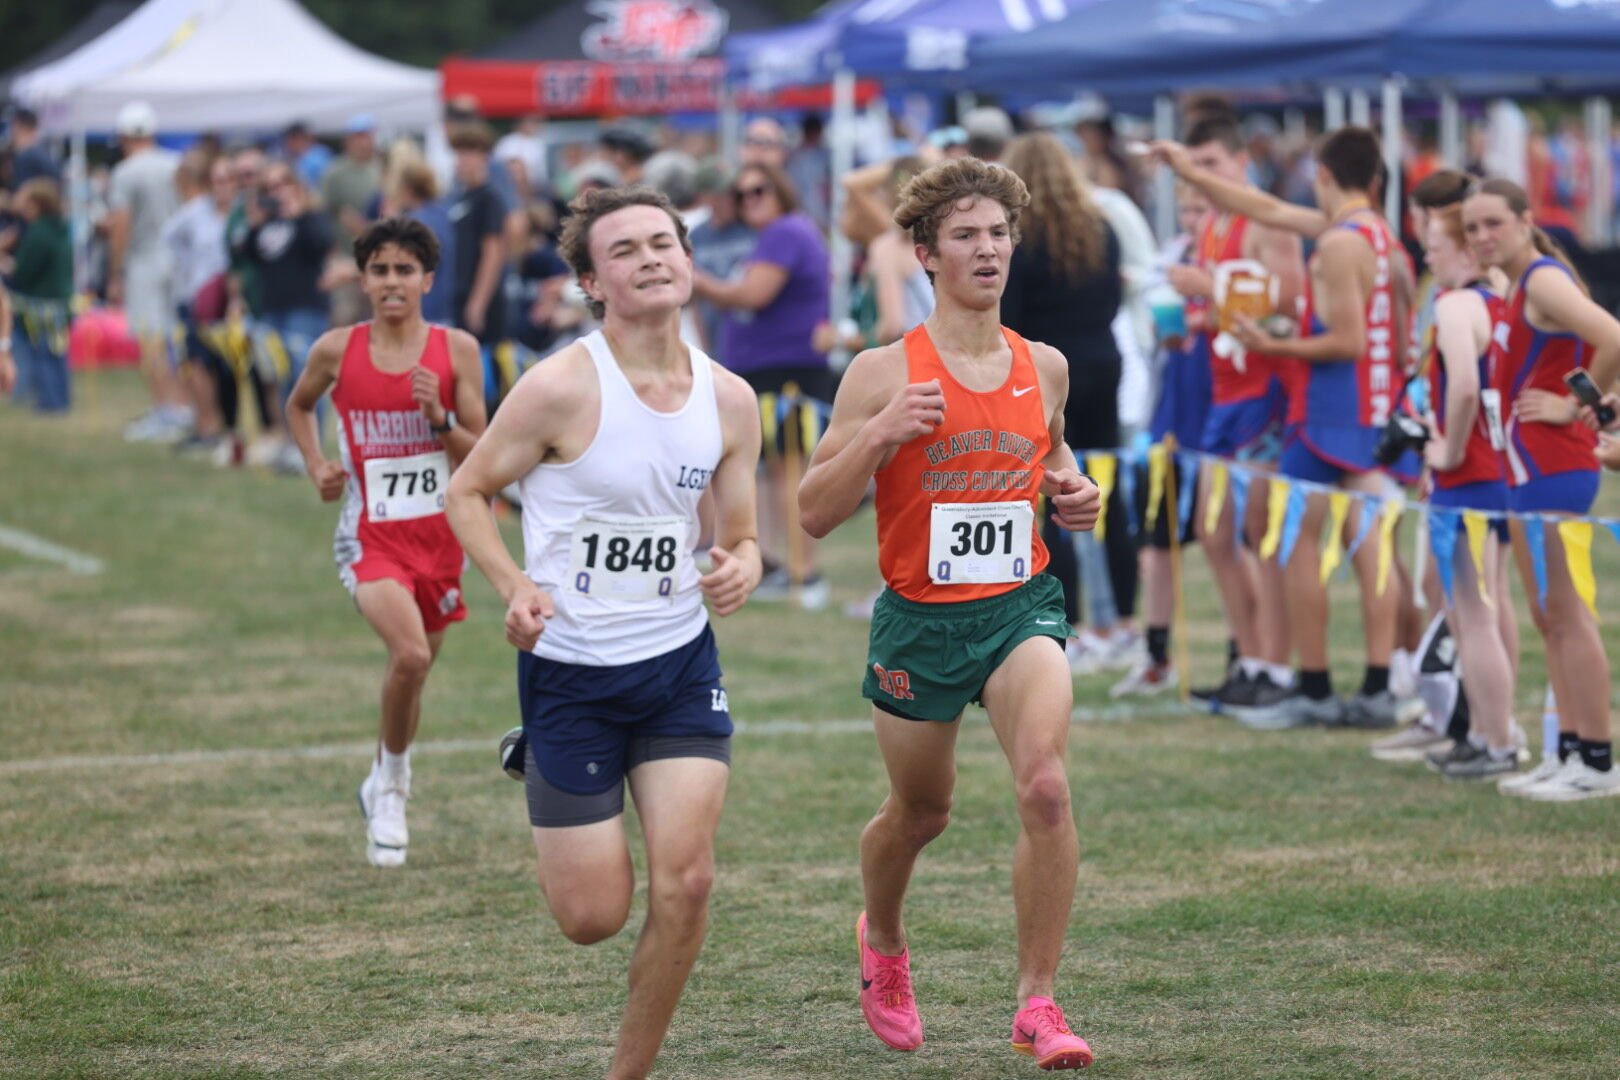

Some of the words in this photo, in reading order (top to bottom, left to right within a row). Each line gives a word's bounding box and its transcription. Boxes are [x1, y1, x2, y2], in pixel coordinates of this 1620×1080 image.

[924, 430, 993, 466] BEAVER
[997, 431, 1037, 465] RIVER
[382, 468, 437, 497] 778
[921, 471, 968, 491] CROSS
[375, 502, 386, 517] Q
[950, 520, 1013, 556] 301
[582, 533, 676, 572] 1848
[937, 560, 951, 581] Q
[1013, 557, 1025, 578] Q
[575, 571, 591, 594] Q
